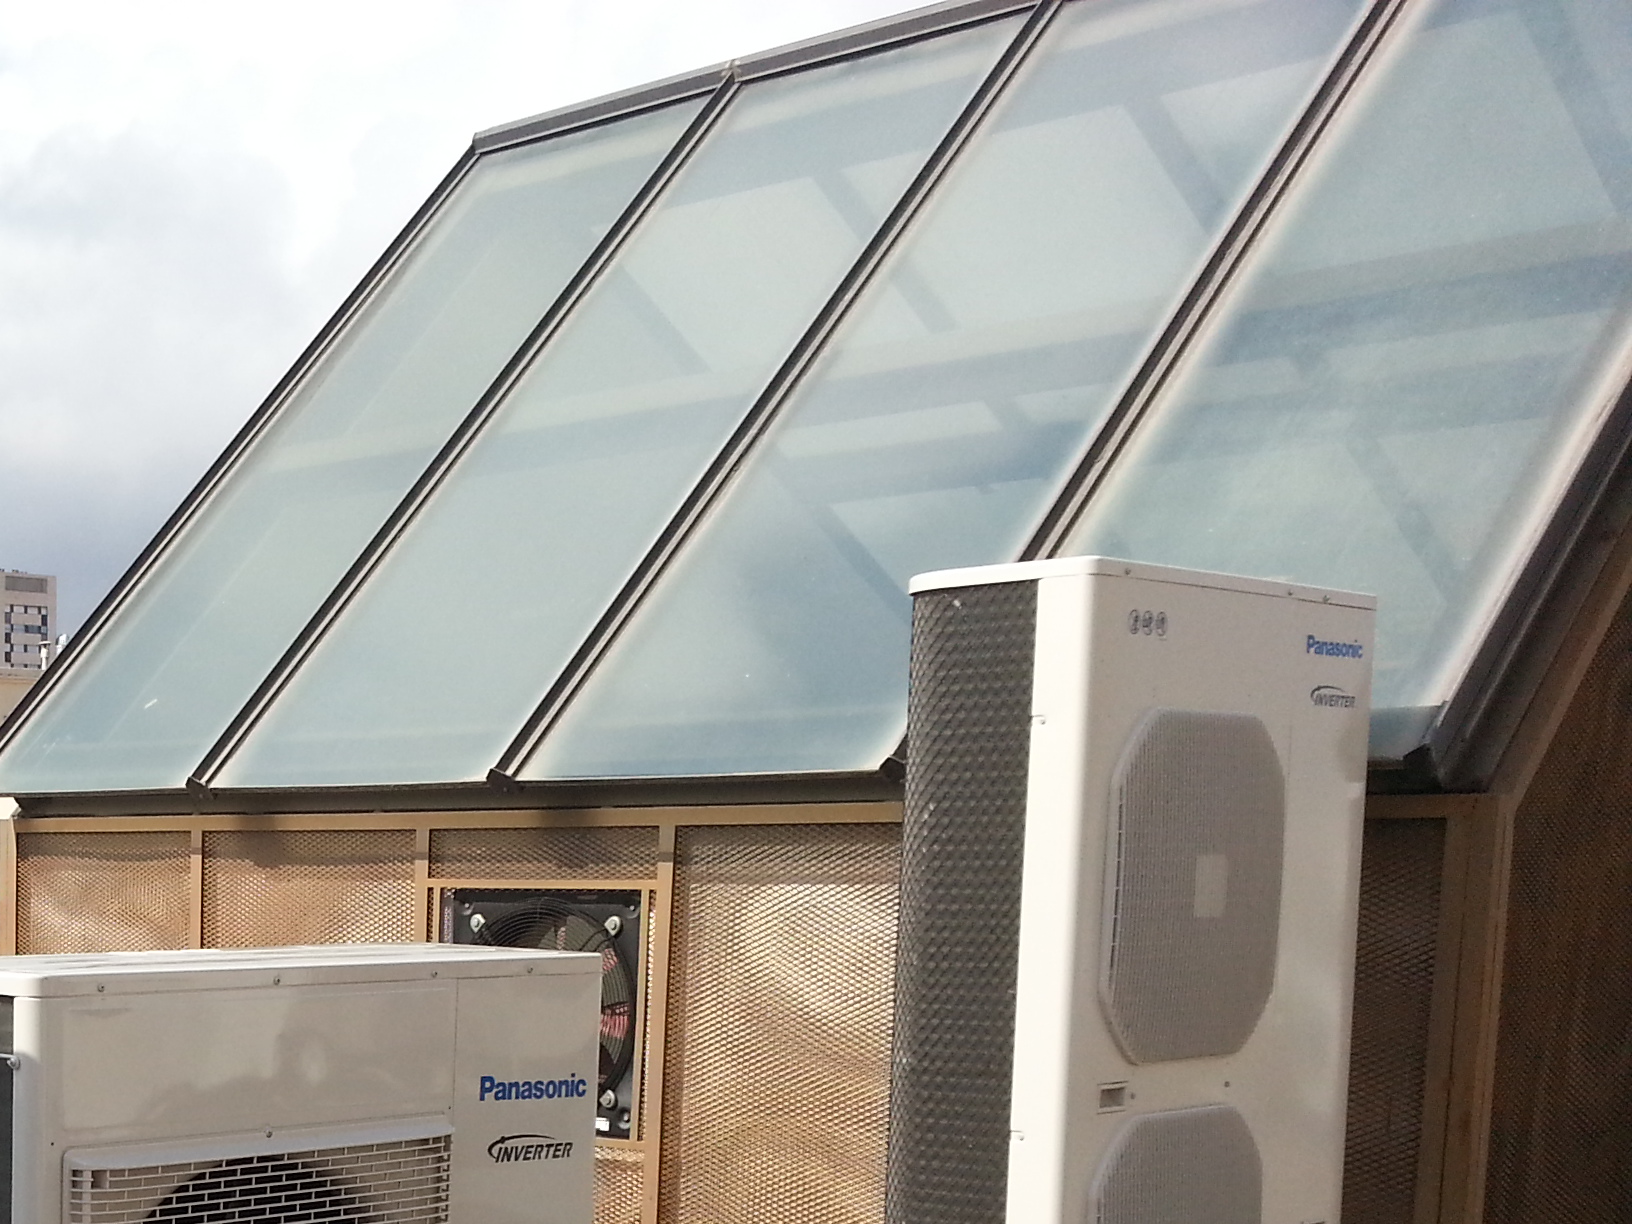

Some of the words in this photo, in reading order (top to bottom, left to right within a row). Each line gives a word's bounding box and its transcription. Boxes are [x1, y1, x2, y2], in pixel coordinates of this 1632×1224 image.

[1307, 635, 1364, 659] Panasonic
[1315, 693, 1356, 708] INVERTER
[479, 1073, 587, 1102] Panasonic
[495, 1142, 573, 1163] INVERTER
